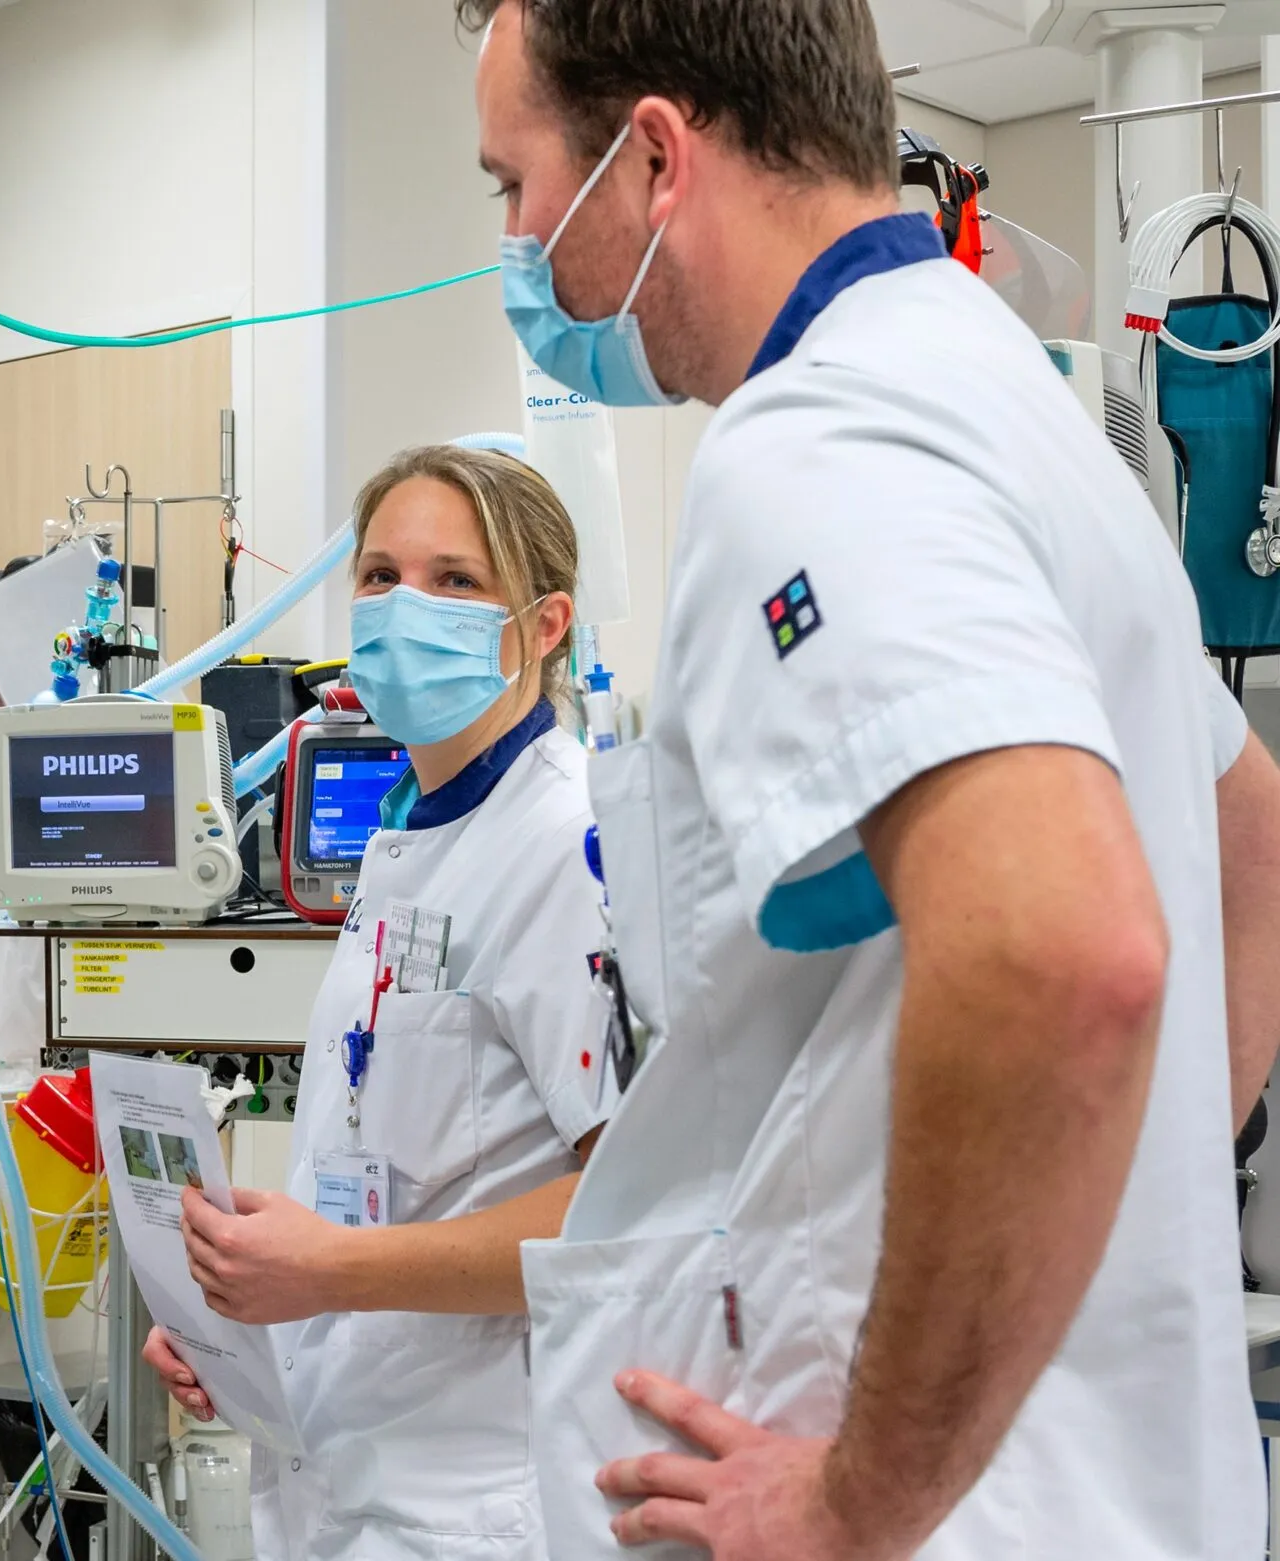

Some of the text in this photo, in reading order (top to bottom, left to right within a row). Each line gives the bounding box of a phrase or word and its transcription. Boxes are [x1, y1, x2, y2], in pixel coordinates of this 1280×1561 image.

[526, 393, 597, 408] Clear-Cu
[177, 711, 197, 720] MP30
[42, 753, 140, 776] PHILIPS
[57, 800, 91, 809] IntelliVue
[71, 885, 113, 895] PHILIPS
